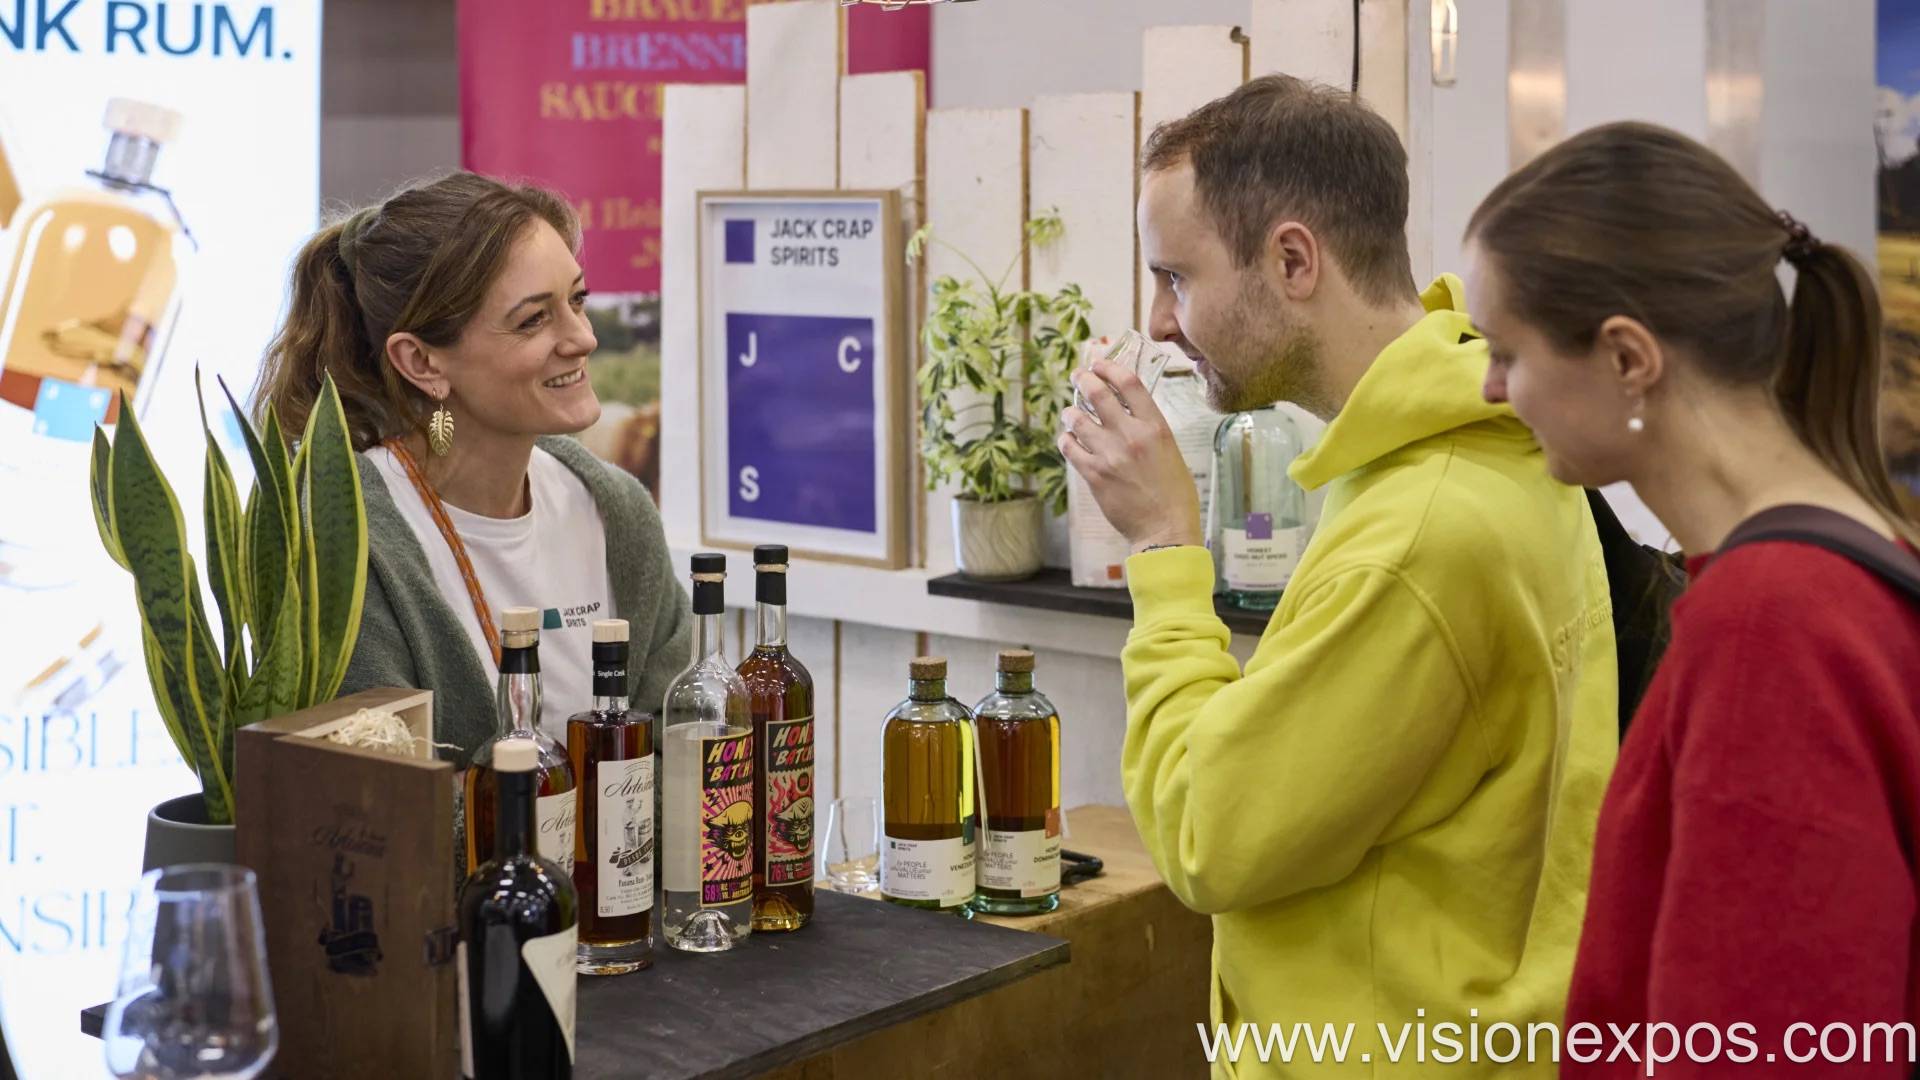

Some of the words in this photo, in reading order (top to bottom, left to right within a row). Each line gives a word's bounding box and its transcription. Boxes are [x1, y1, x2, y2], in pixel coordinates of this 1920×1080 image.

[105, 1, 293, 59] RUM.
[769, 218, 818, 240] JACK
[821, 218, 874, 241] CRAP
[769, 245, 841, 268] SPIRITS
[739, 332, 758, 368] J
[837, 336, 862, 374] C
[738, 465, 760, 502] S
[575, 602, 601, 616] CRAP
[897, 871, 926, 880] MATTERS
